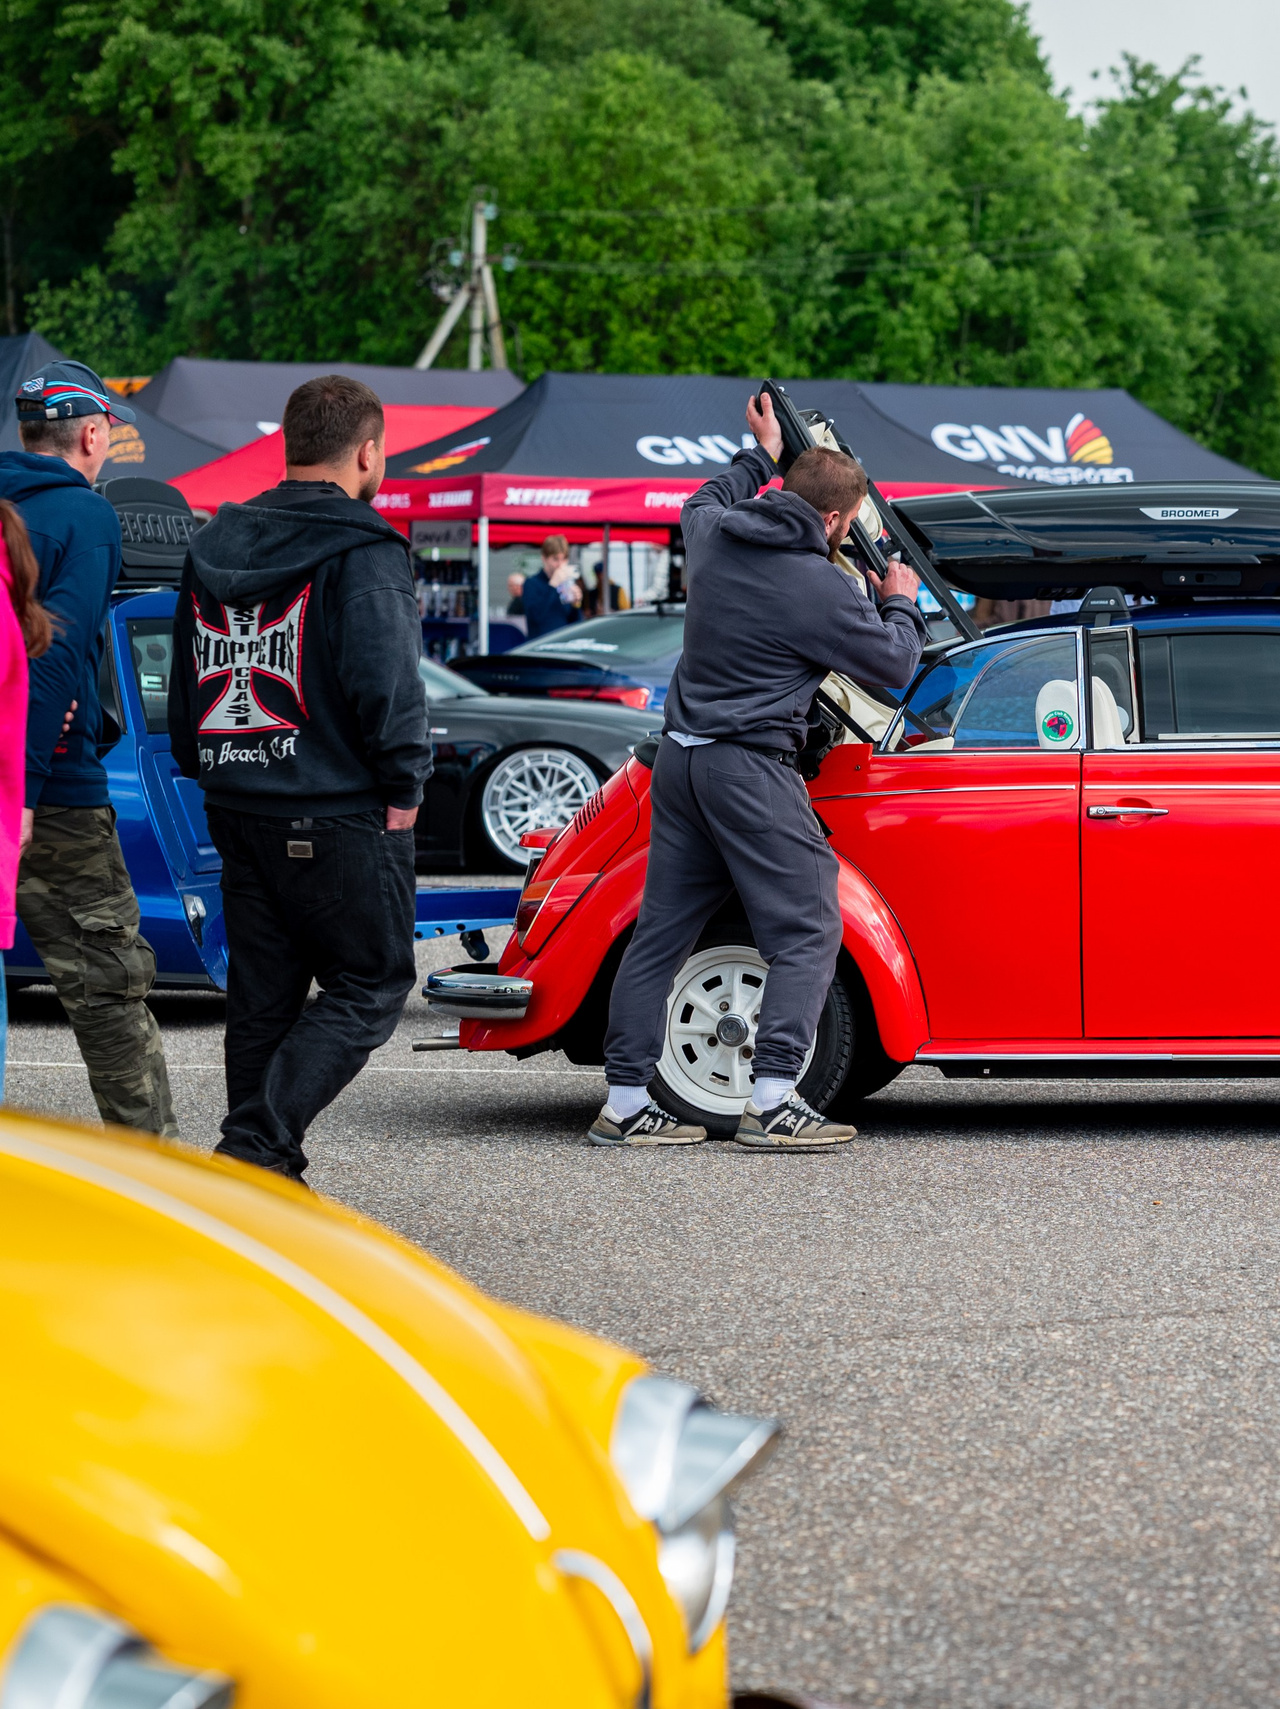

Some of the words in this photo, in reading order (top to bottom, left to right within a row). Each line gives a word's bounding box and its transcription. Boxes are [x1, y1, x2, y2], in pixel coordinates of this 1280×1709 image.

[931, 423, 1067, 463] GNV
[504, 487, 592, 507] XENUM
[644, 492, 696, 508] ПРИС
[1160, 509, 1220, 518] BROOMER
[193, 620, 295, 679] HOPPERS
[224, 667, 252, 726] COAST
[217, 741, 269, 769] Beach,
[270, 736, 297, 760] CA
